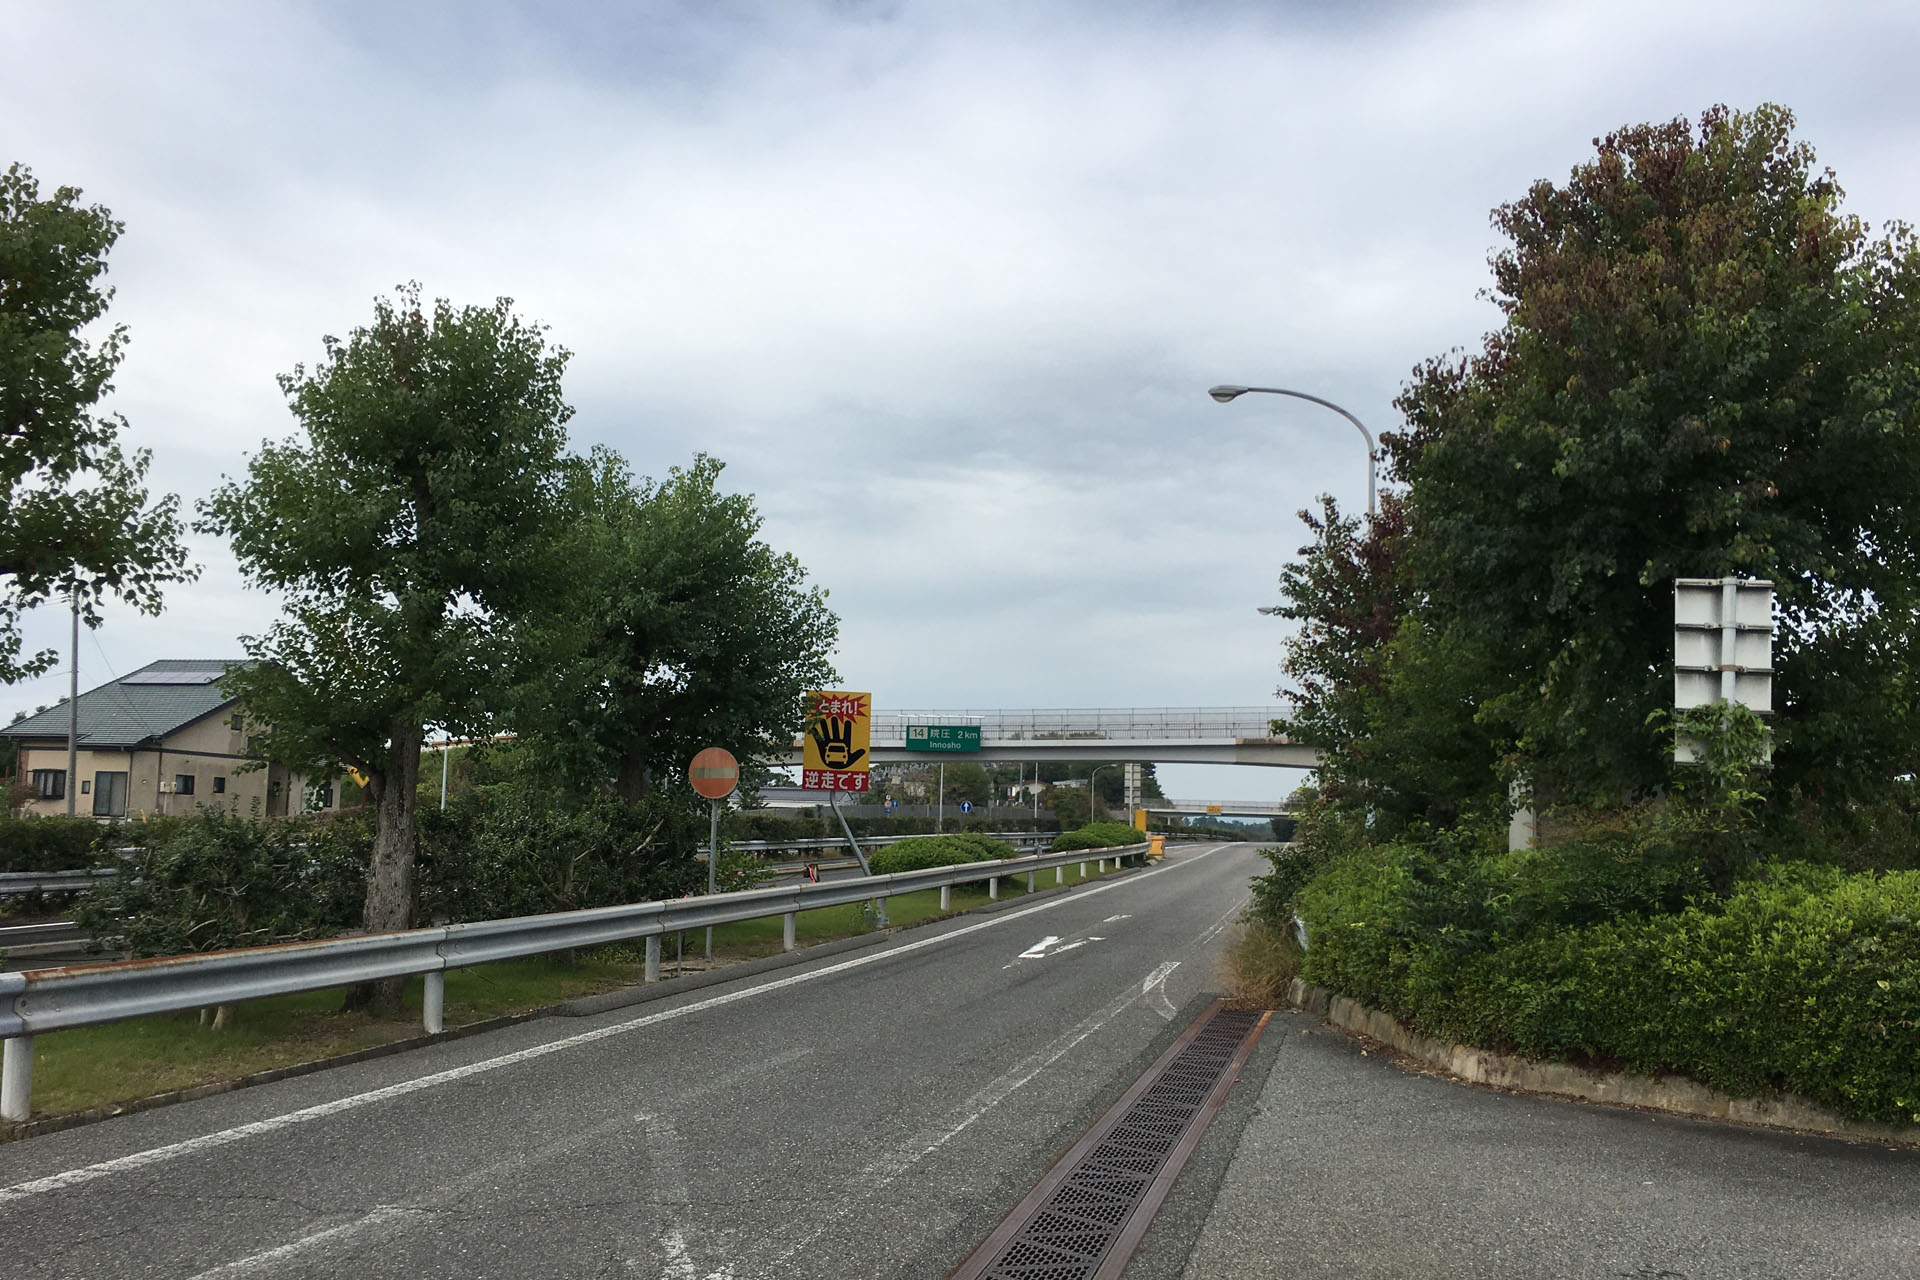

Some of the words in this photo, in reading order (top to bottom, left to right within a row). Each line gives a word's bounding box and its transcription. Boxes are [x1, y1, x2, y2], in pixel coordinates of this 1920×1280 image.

[818, 700, 858, 715] とまれ!
[913, 728, 924, 738] 14
[930, 741, 961, 749] Innosho
[805, 771, 866, 790] 逆走です
